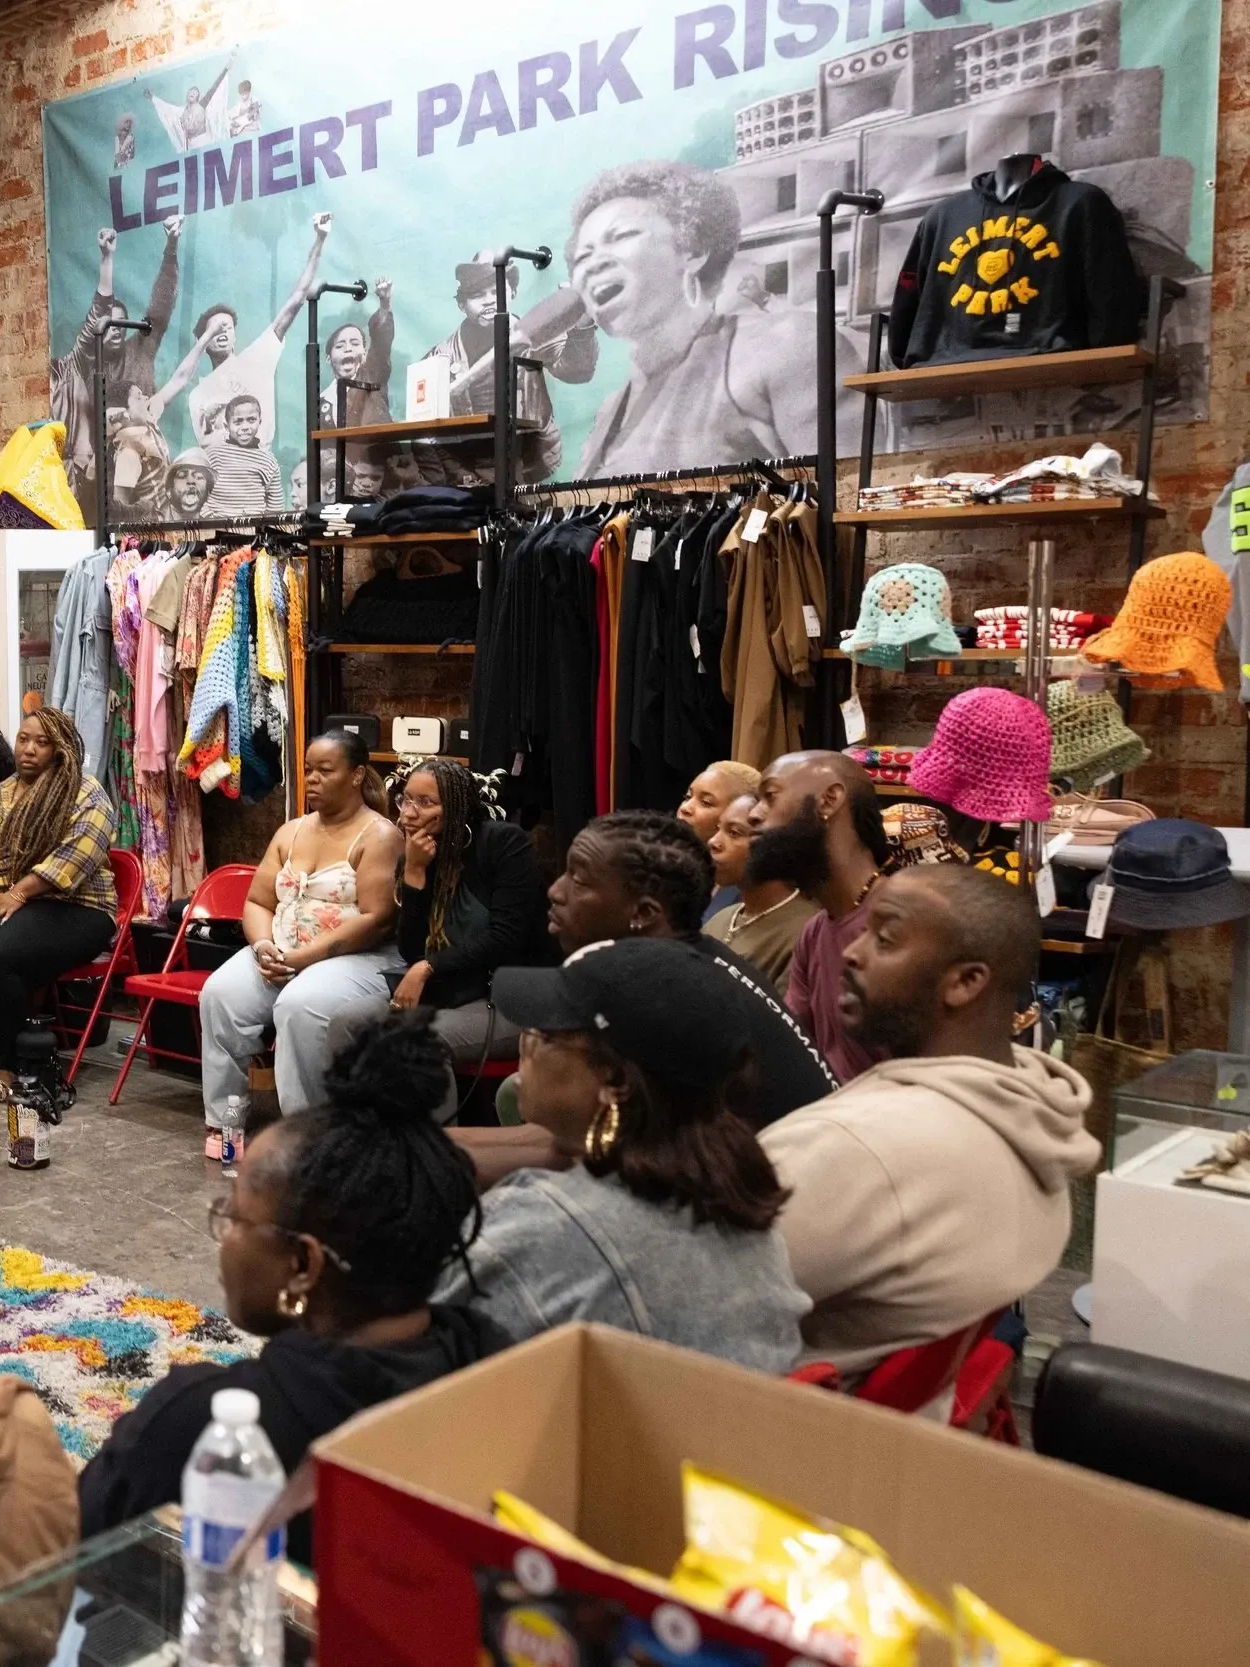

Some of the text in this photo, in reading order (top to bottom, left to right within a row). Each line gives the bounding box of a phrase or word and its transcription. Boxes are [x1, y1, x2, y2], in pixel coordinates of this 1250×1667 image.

[108, 0, 1026, 233] LEIMERT PARK RISI
[938, 215, 1060, 275] LEIMERT
[950, 276, 1039, 315] PARK
